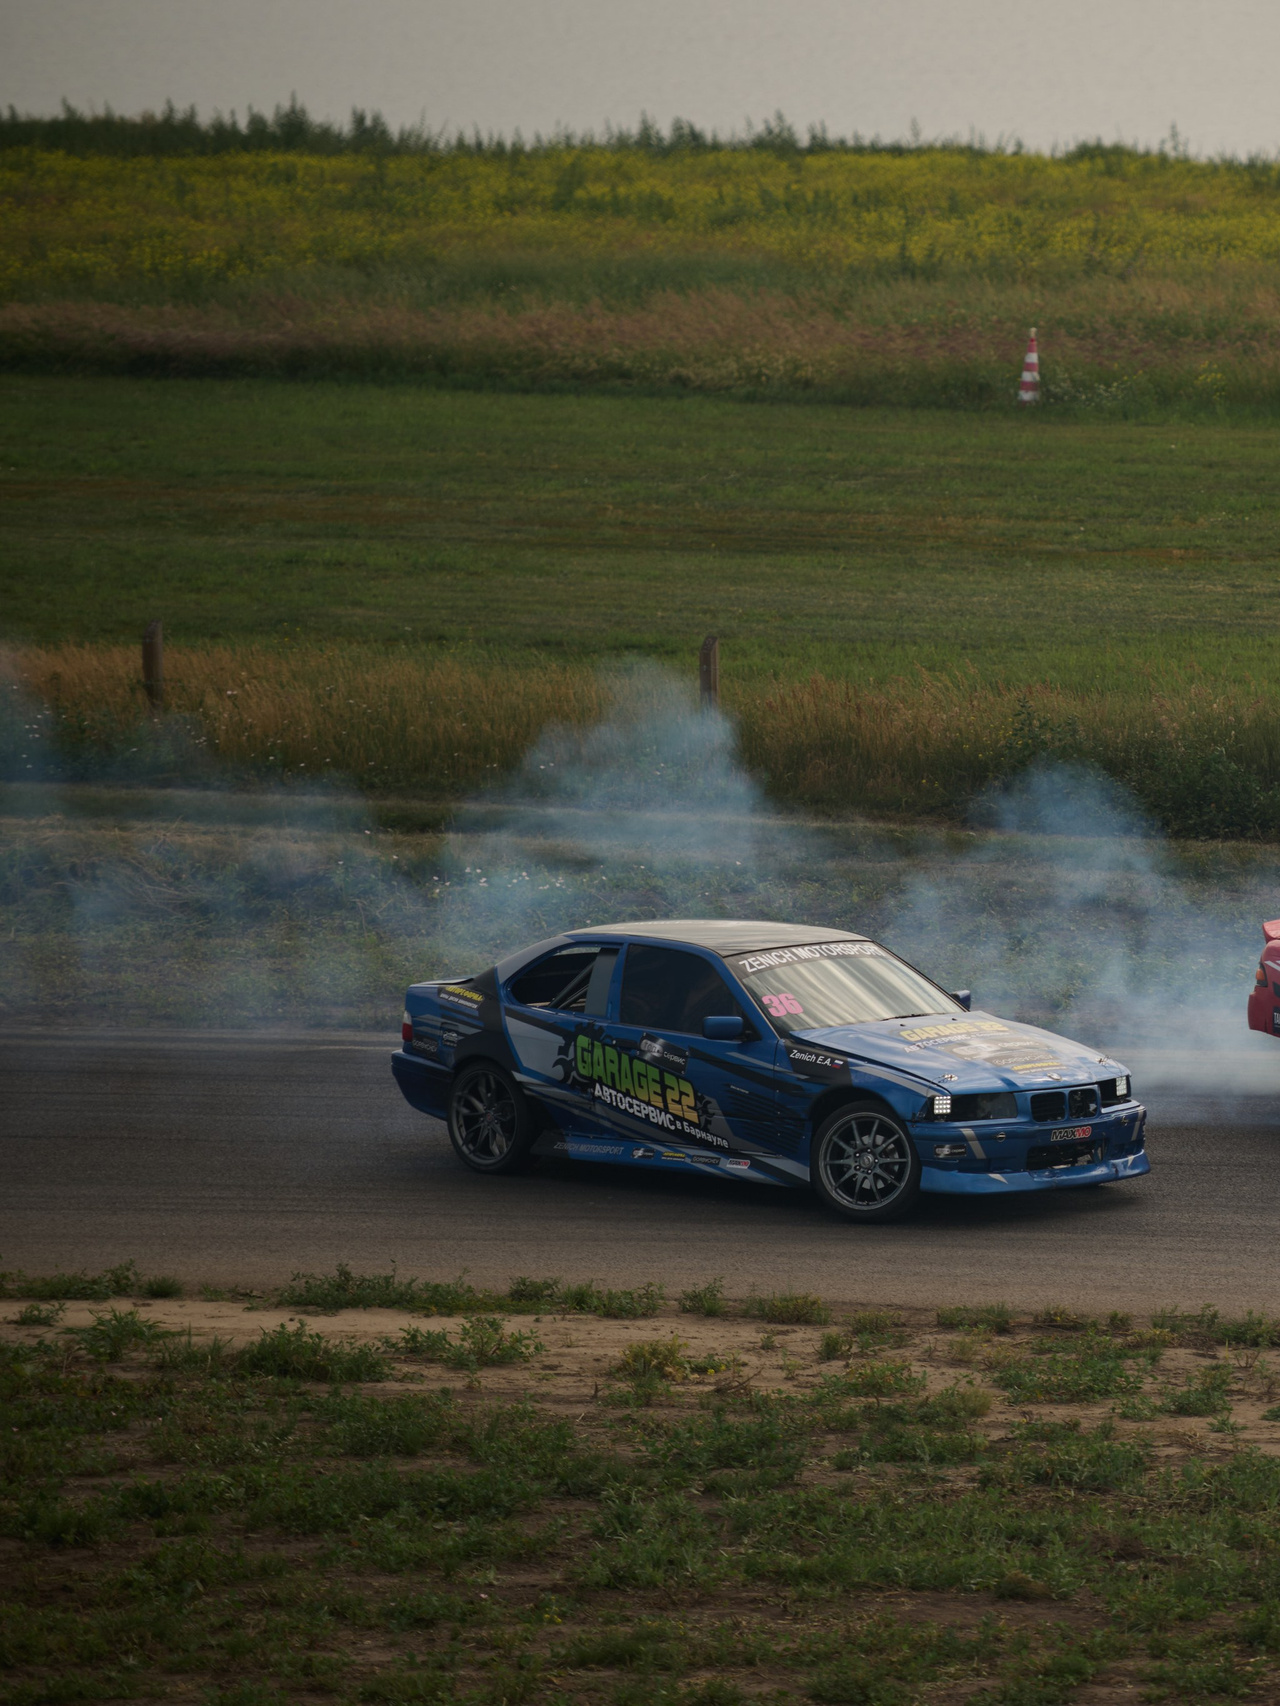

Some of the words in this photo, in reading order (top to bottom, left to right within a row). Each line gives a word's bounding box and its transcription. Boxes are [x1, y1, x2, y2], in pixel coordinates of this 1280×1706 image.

[738, 950, 797, 973] ZENICH
[794, 944, 886, 960] MOTORSPORT
[761, 993, 803, 1017] 36
[900, 1022, 979, 1042] GARAGE
[789, 1049, 816, 1062] Zenich
[816, 1056, 832, 1066] E.A.
[576, 1034, 664, 1109] GARAGE
[663, 1072, 699, 1124] 22
[594, 1083, 676, 1131] АВТОСЕРВИС
[675, 1120, 682, 1129] в
[684, 1122, 729, 1149] Барнауле
